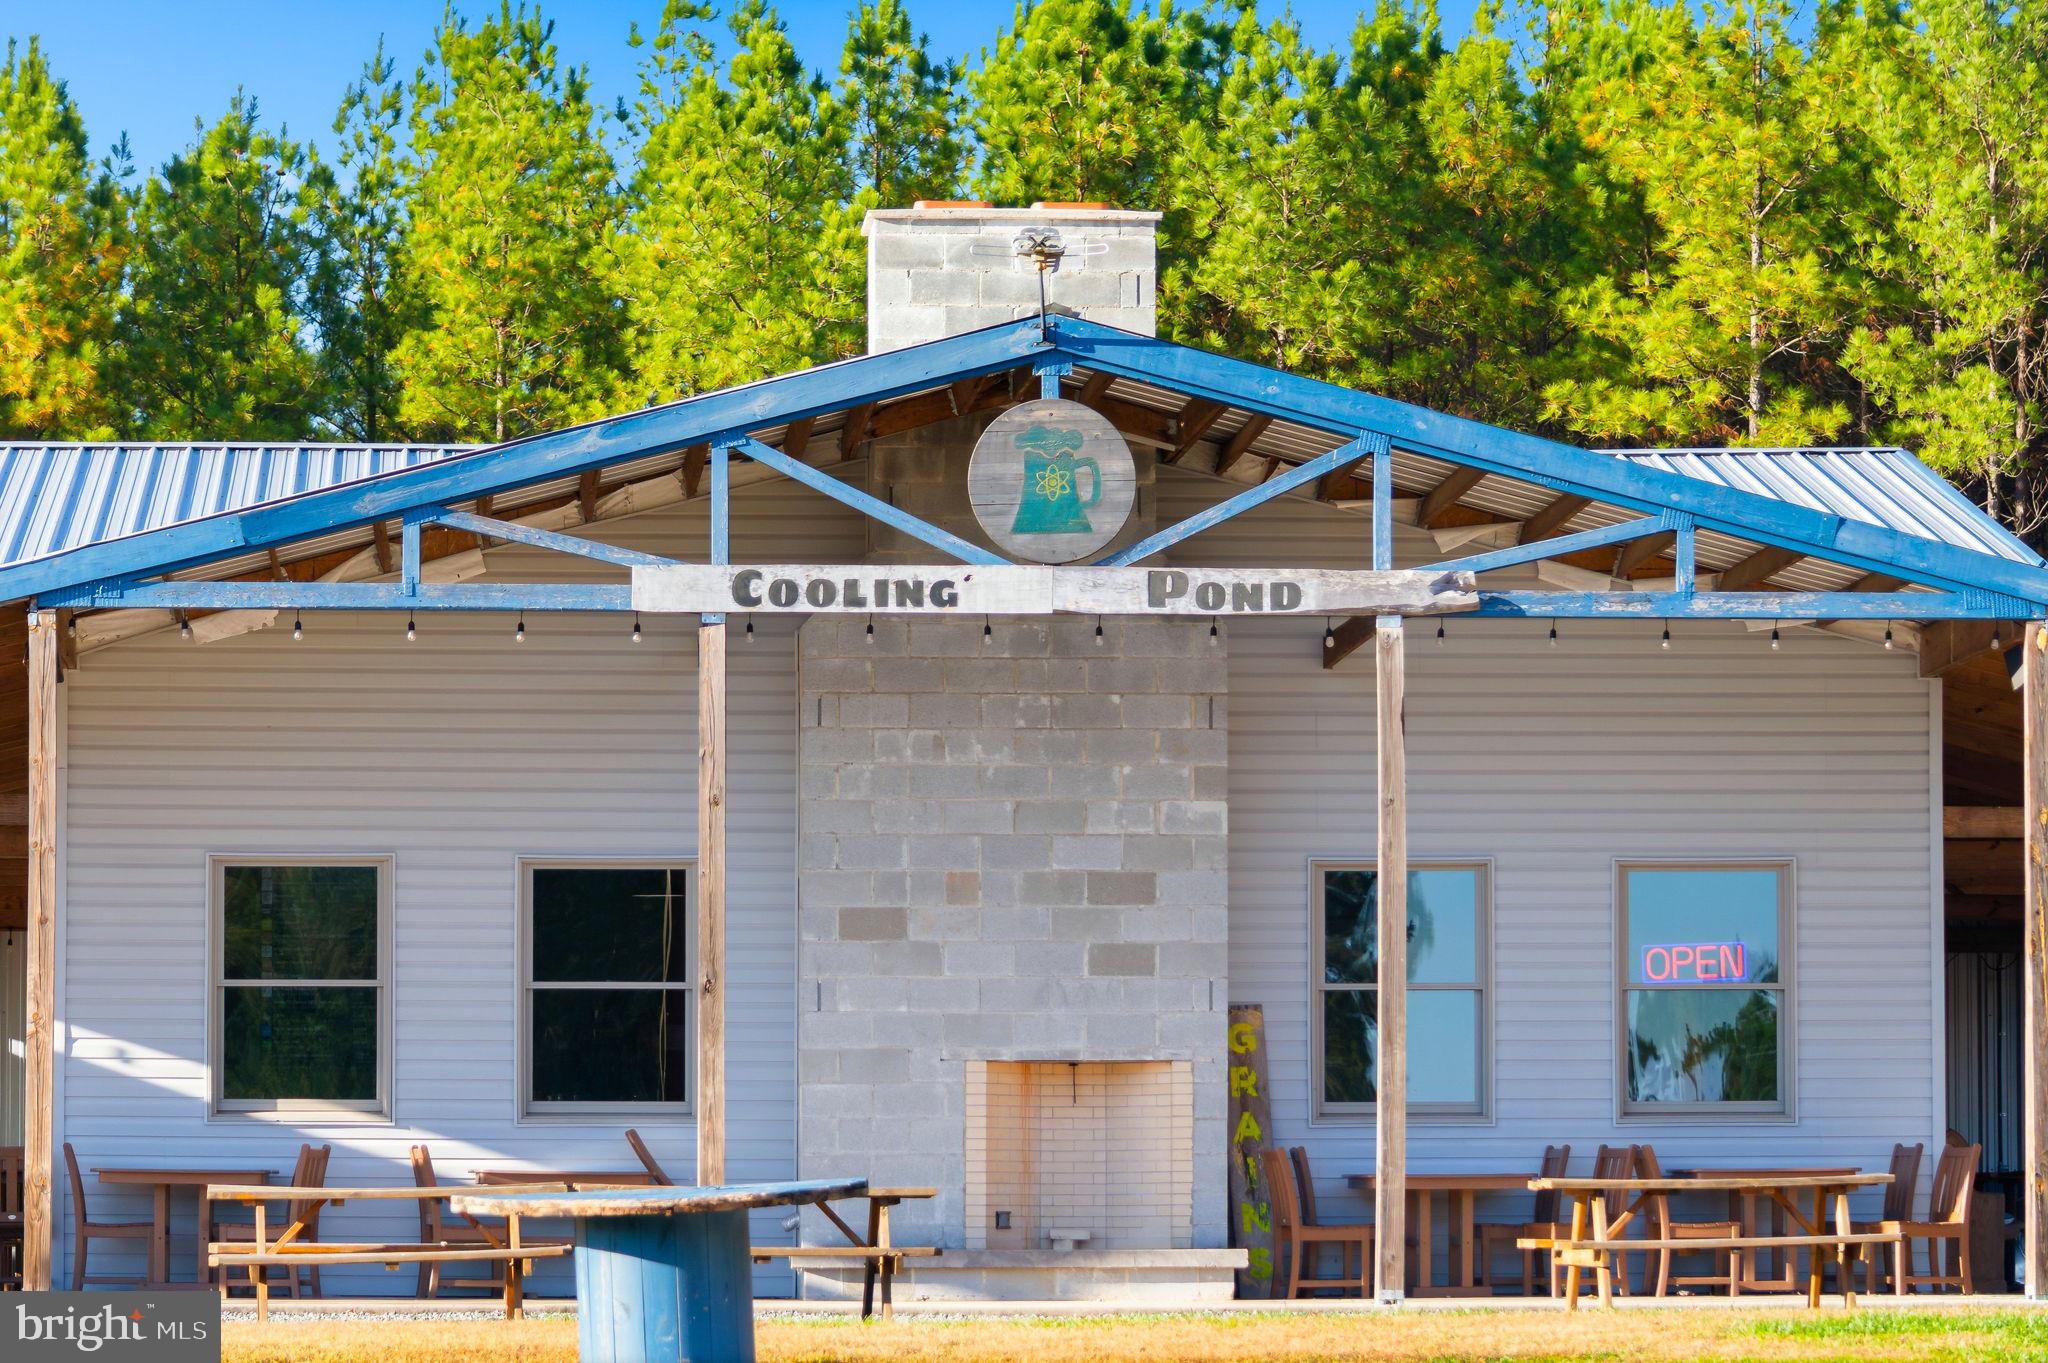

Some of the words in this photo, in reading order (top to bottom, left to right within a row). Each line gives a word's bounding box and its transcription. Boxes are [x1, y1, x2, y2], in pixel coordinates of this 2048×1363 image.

[731, 568, 959, 608] COOLING
[1147, 570, 1302, 612] POND
[1645, 943, 1745, 980] OPEN
